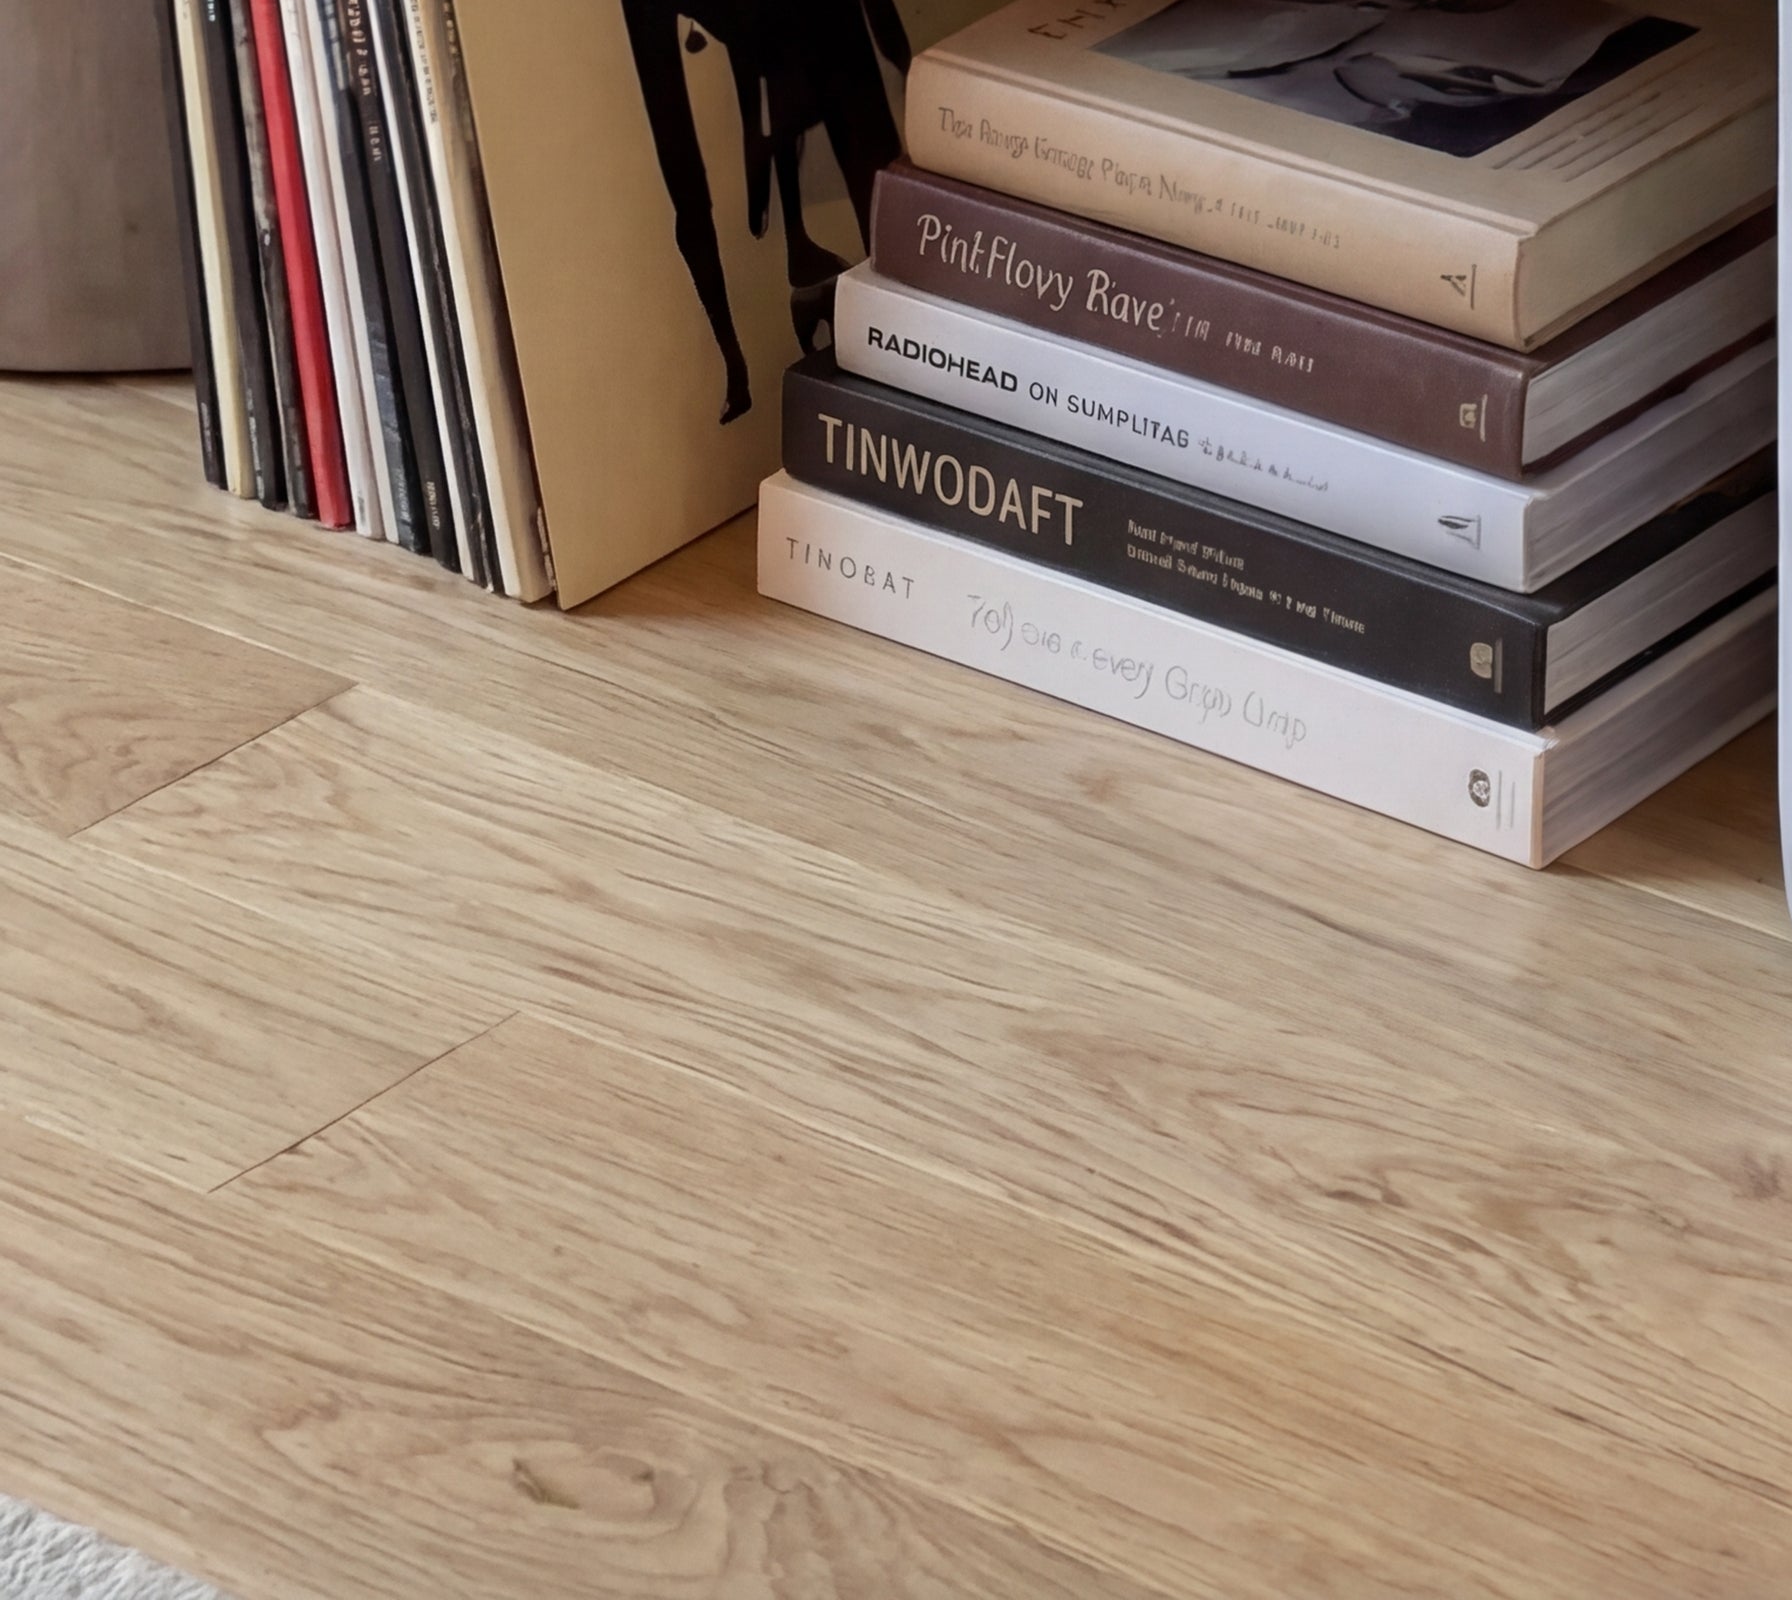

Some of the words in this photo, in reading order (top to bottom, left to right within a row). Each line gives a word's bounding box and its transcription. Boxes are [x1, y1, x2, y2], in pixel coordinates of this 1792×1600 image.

[867, 325, 1019, 393] RADIOHEAD
[1028, 380, 1060, 408] ON
[817, 412, 1085, 547] TINWODAFT
[785, 536, 916, 601] TINOBAT
